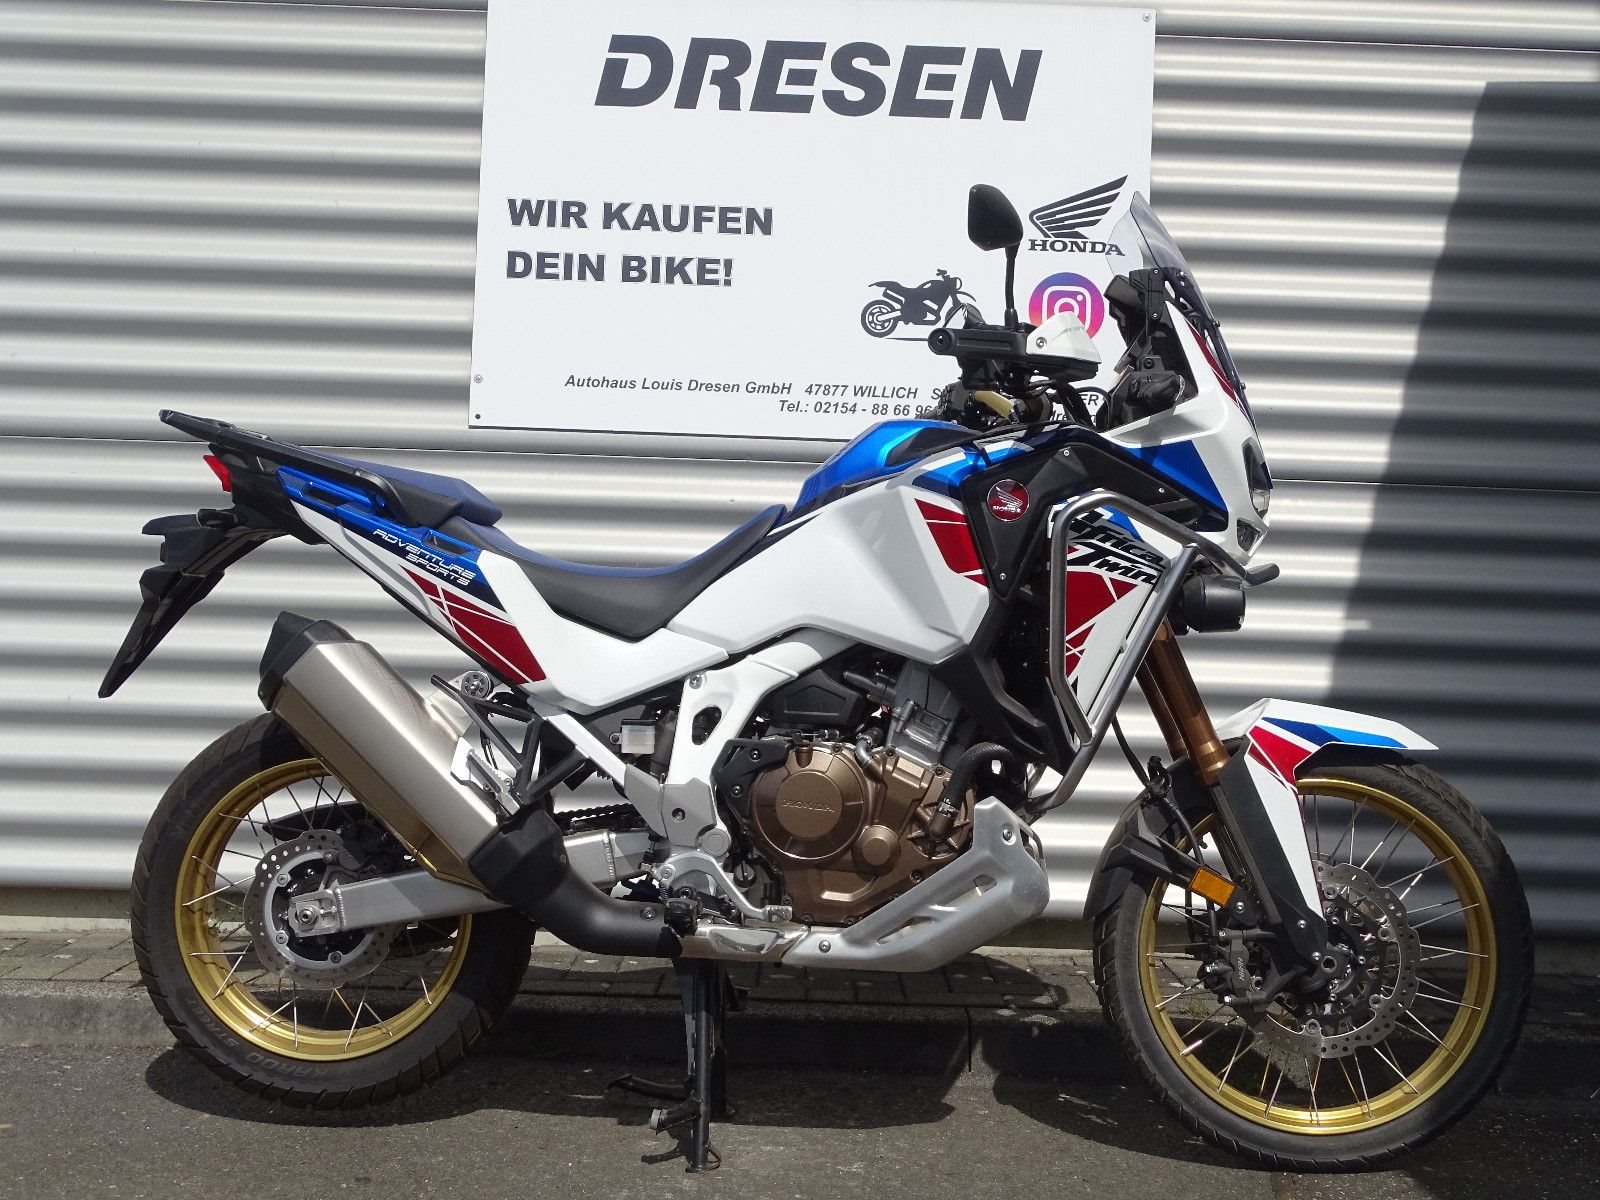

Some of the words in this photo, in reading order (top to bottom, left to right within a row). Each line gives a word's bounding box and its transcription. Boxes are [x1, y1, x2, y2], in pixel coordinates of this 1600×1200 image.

[594, 33, 1044, 122] DRESEN
[506, 198, 588, 230] WIR
[601, 201, 774, 236] KAUFEN
[1028, 238, 1126, 257] HONDA
[506, 250, 606, 283] DEIN
[620, 253, 734, 287] BIKE!
[564, 374, 637, 390] Autohaus
[641, 377, 683, 391] Louis
[687, 379, 740, 393] Dresen
[745, 381, 793, 395] GmbH
[804, 383, 849, 397] 47877
[853, 385, 918, 400] WILLICH
[778, 399, 808, 413] Tel.:
[813, 401, 857, 415] 02154
[871, 403, 889, 417] 88
[893, 404, 911, 417] 66
[373, 528, 477, 580] ADVENTURE
[405, 552, 470, 587] SPORTS
[782, 799, 835, 813] HONDA
